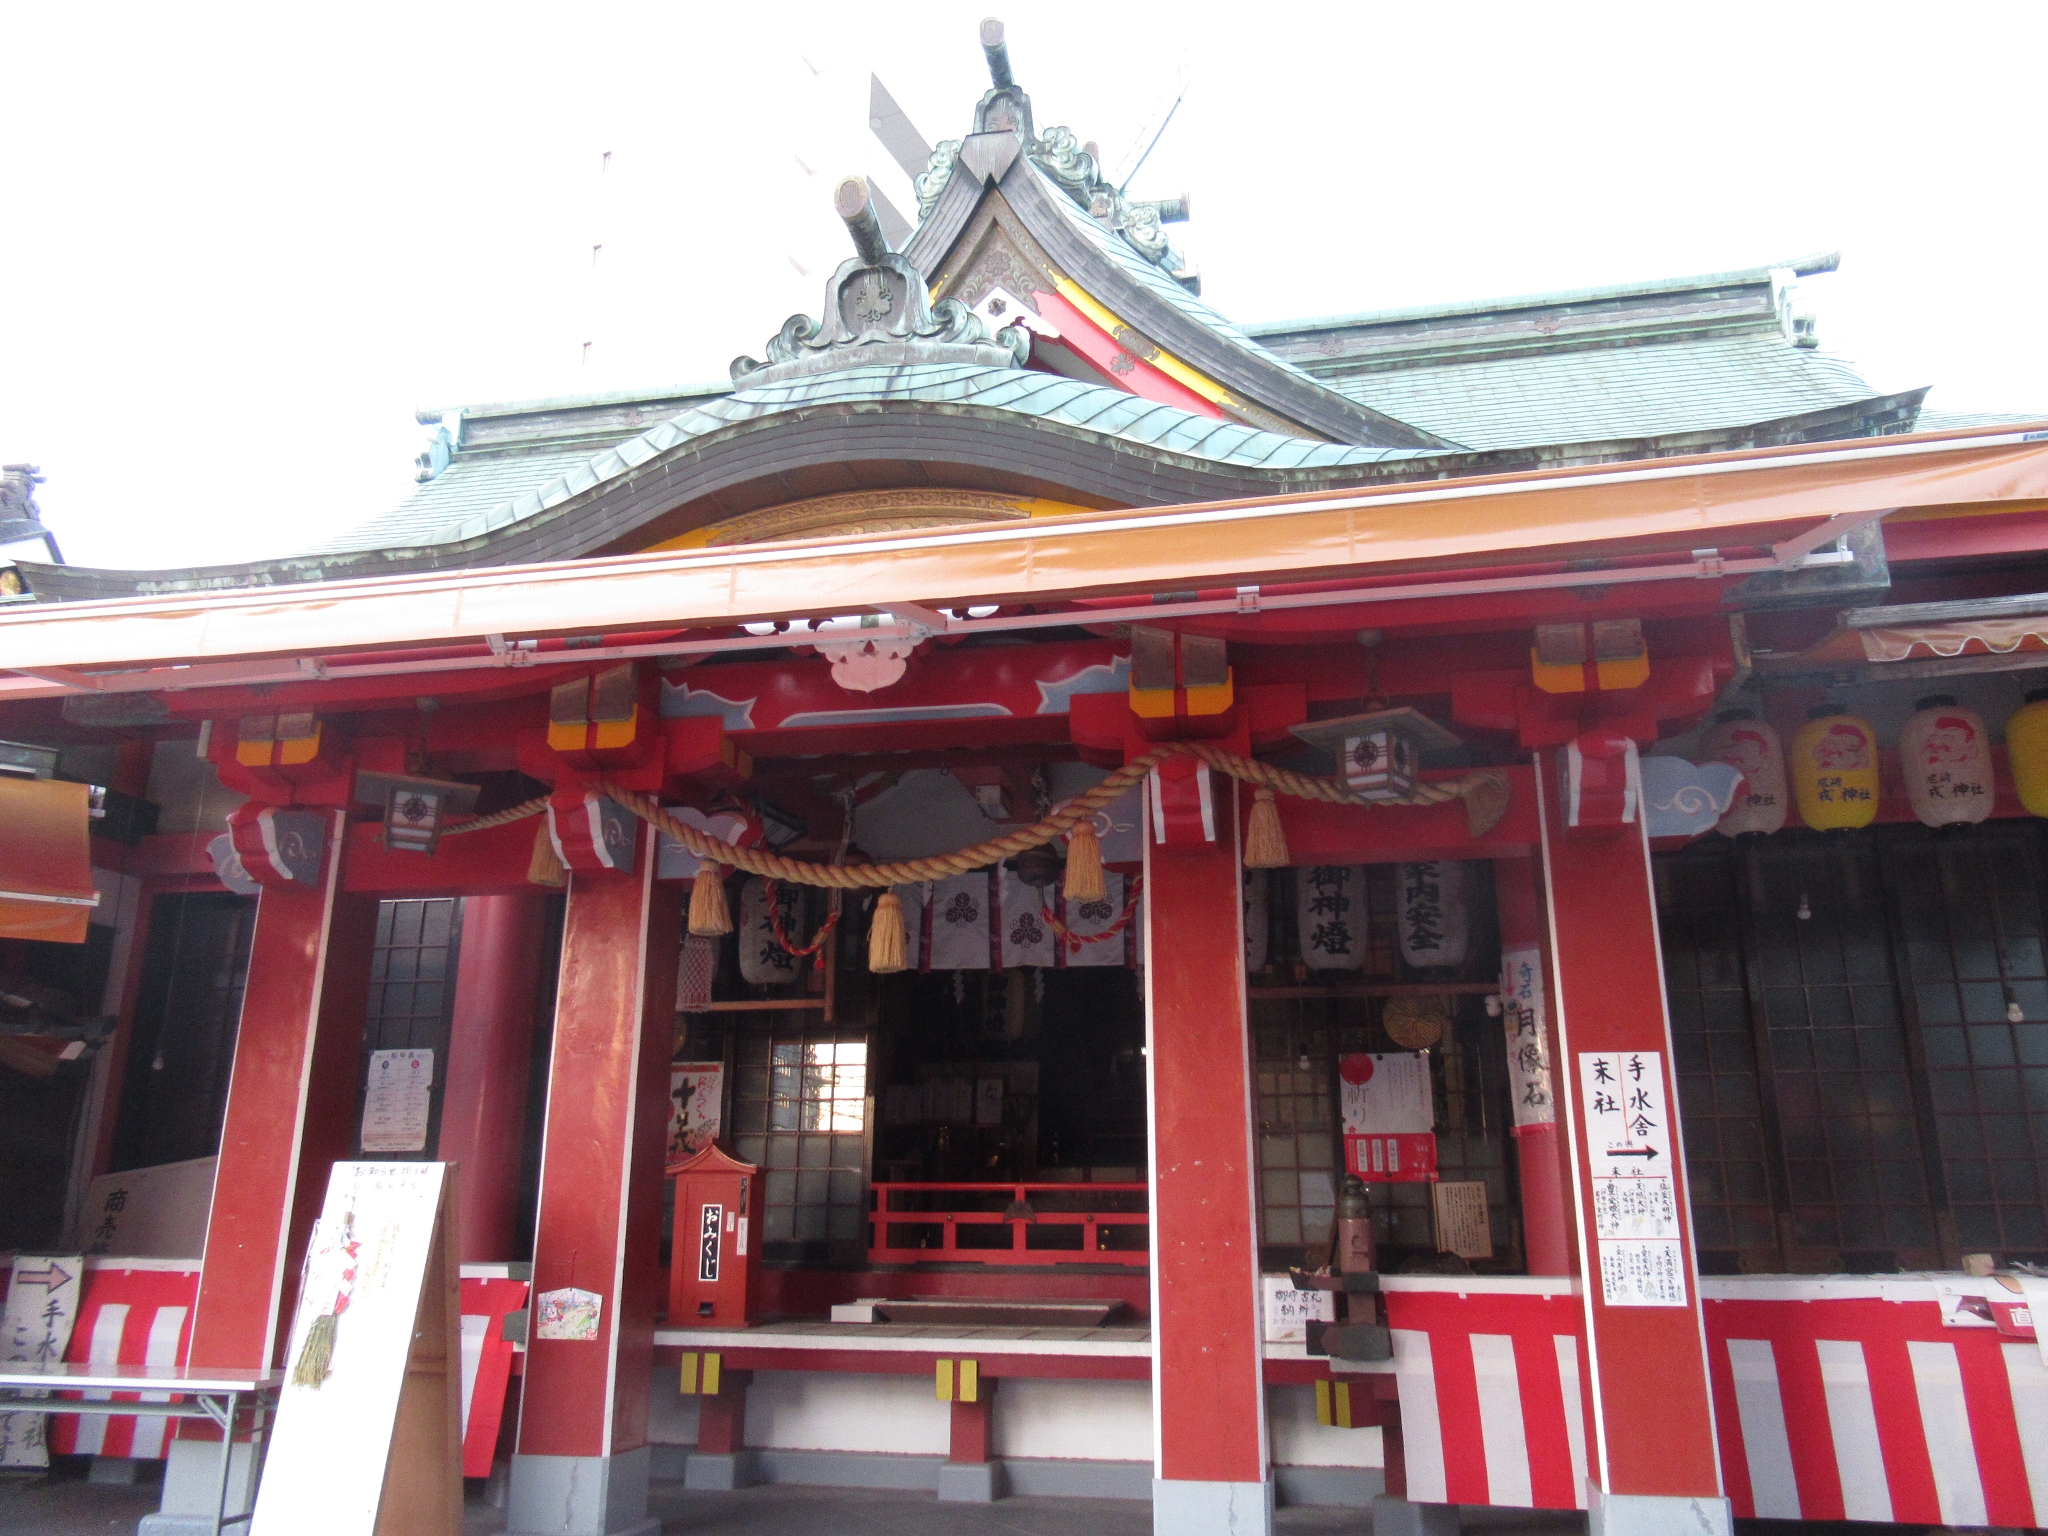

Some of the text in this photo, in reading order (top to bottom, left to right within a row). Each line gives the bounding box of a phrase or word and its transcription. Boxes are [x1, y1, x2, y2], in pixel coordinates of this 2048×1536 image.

[1592, 1057, 1620, 1115] 末社
[1628, 1054, 1658, 1136] 手水舎
[703, 1208, 719, 1277] おみくじ
